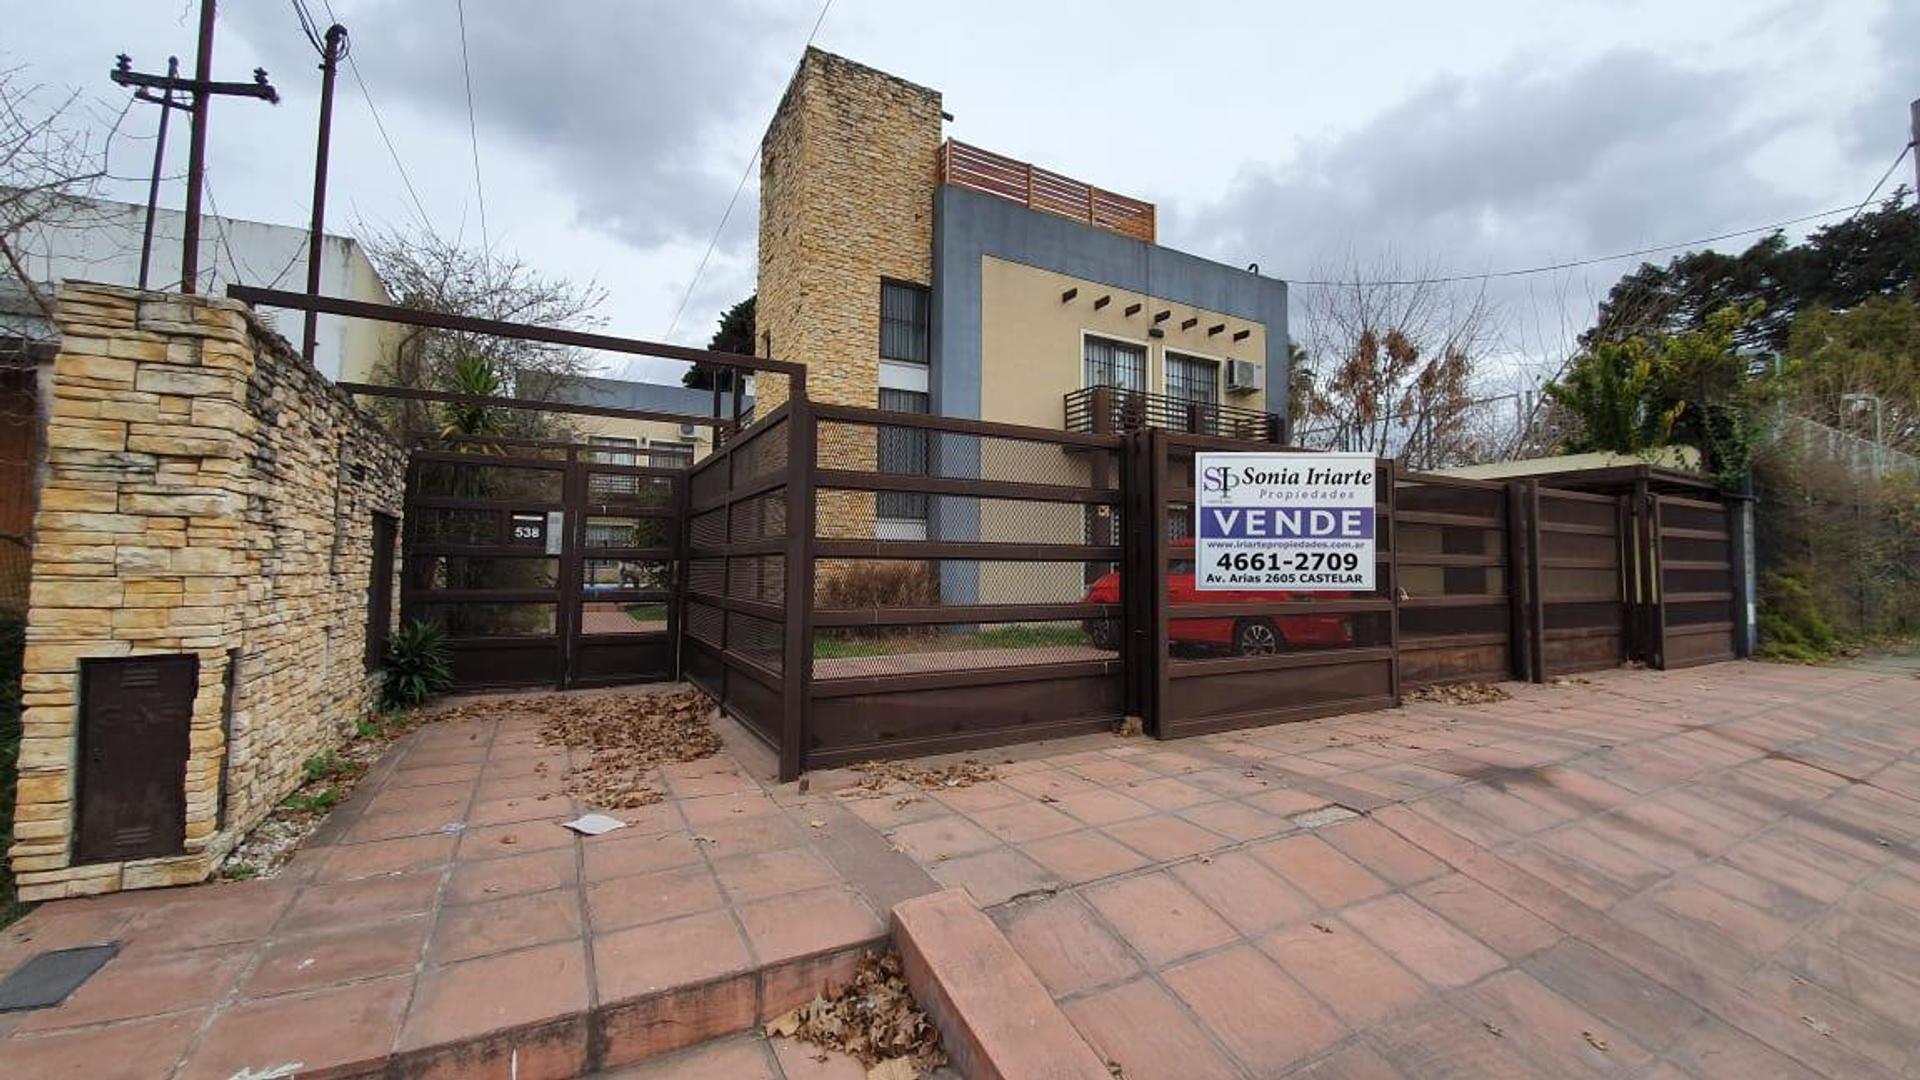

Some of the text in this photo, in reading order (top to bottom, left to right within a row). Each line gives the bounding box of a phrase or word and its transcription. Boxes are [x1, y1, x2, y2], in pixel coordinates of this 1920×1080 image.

[1241, 466, 1372, 486] Sonia Iriarte
[1259, 488, 1355, 502] Propiedades
[1213, 509, 1362, 536] VENDE
[514, 526, 540, 538] 538
[1207, 540, 1365, 550] www.iriartepropiedades.com.ar
[1216, 552, 1358, 571] 4661-2709
[1206, 573, 1363, 584] Av. Arias 2605 CASTELAR
